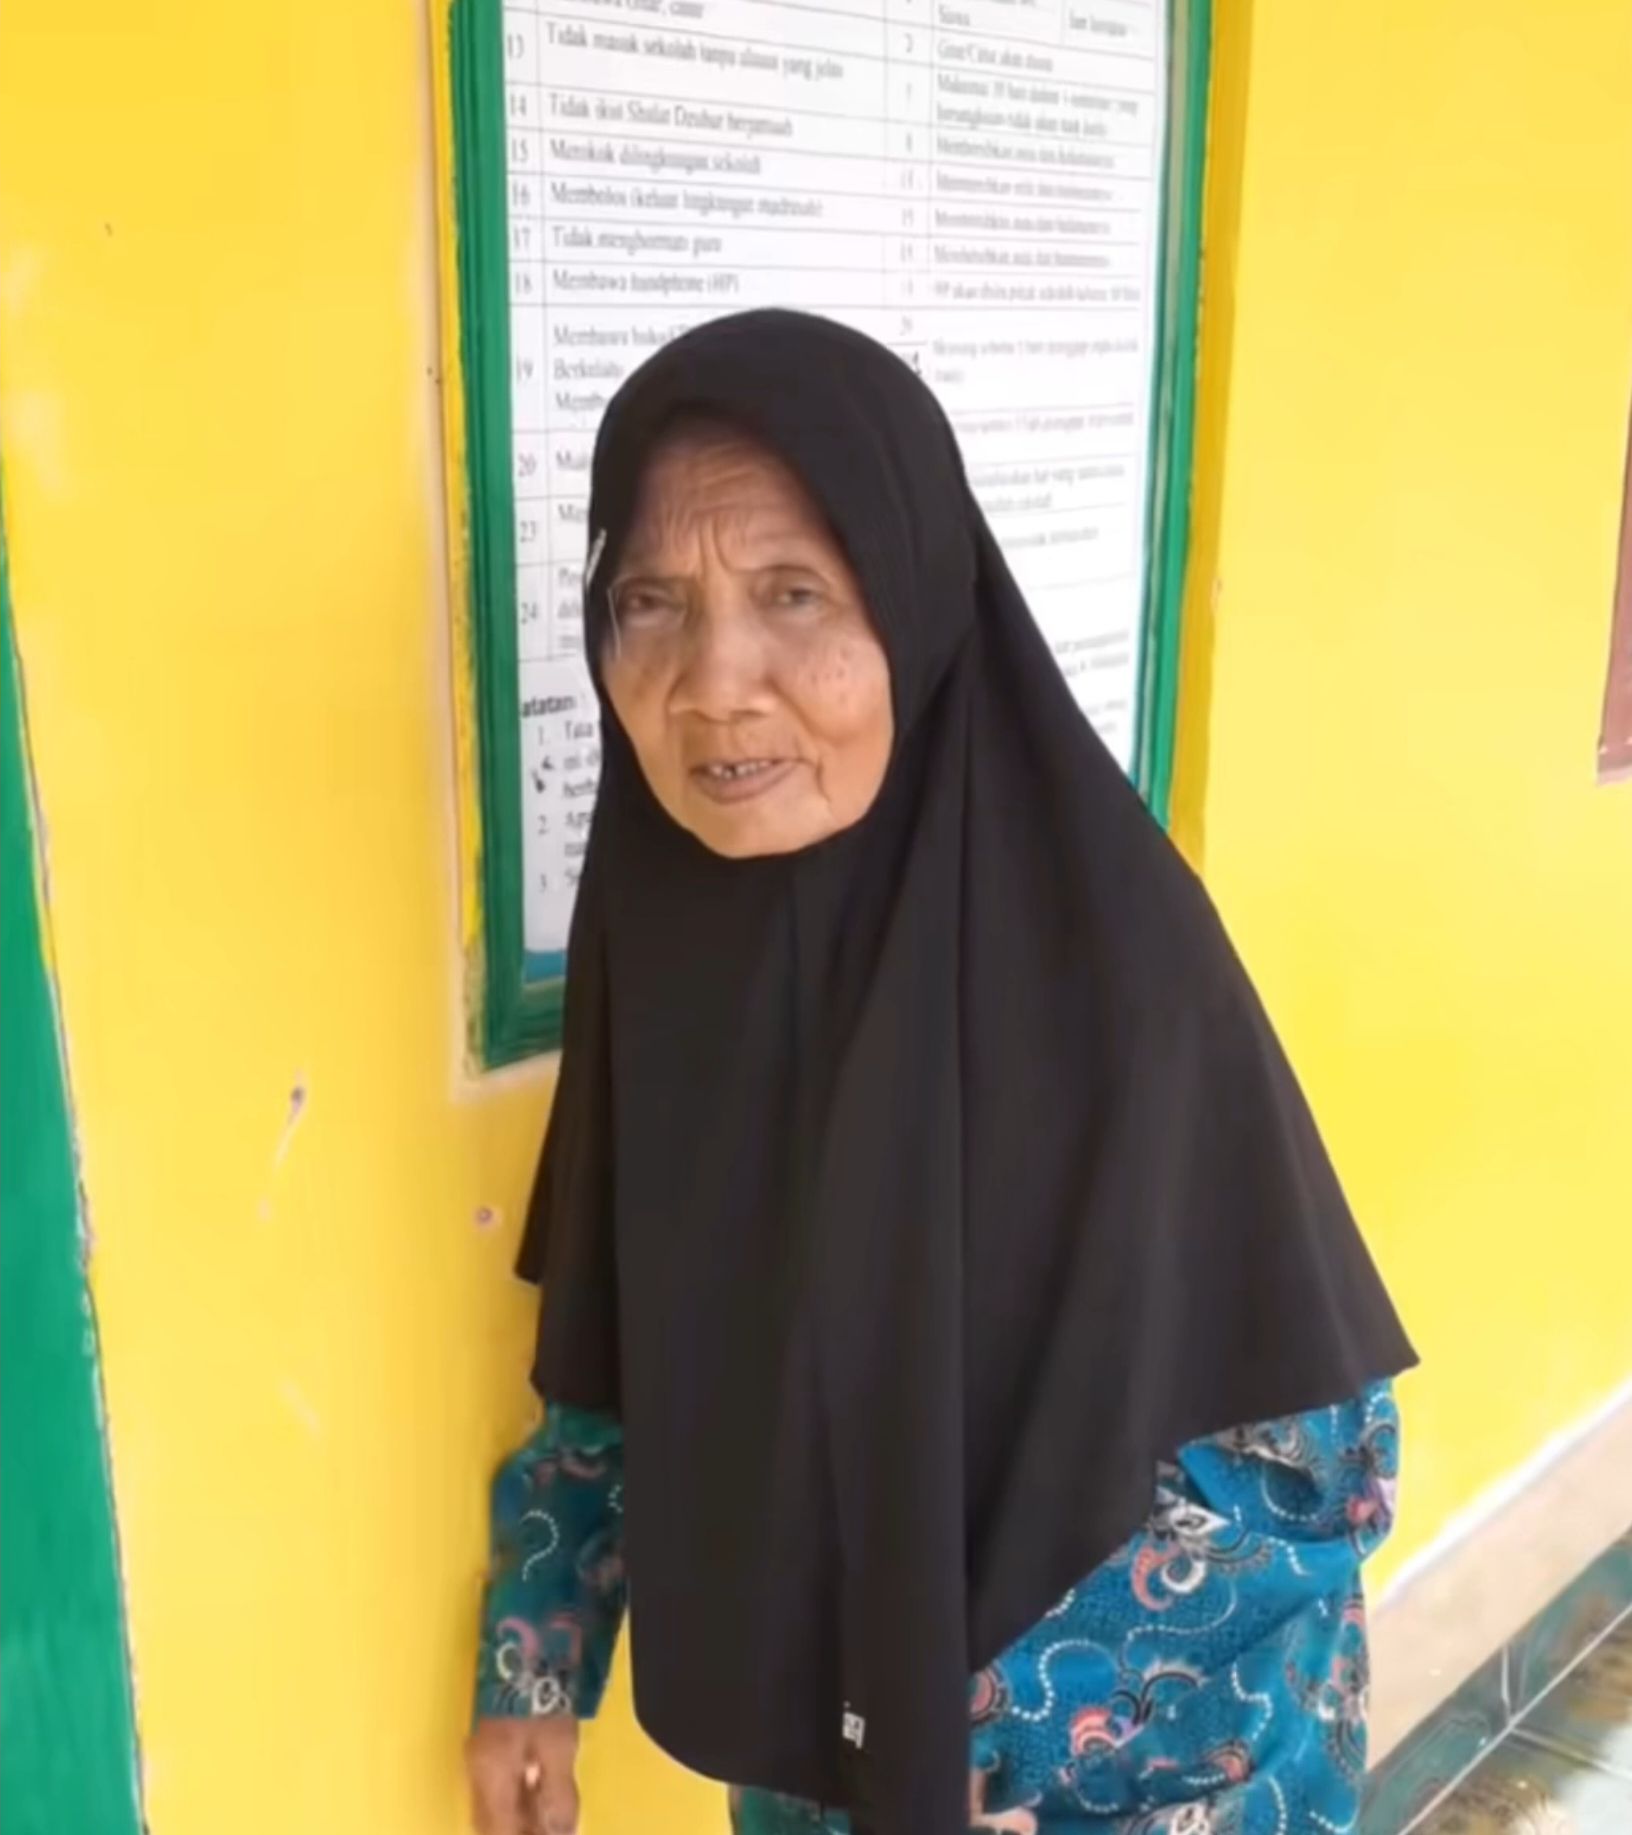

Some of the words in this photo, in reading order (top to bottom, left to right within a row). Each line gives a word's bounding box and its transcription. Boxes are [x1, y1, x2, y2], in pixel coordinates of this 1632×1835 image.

[546, 21, 587, 47] Tidak
[593, 33, 639, 53] masuk
[643, 36, 697, 61] sekolah
[509, 93, 527, 117] 14
[549, 92, 590, 118] Tidak
[511, 138, 528, 163] 15
[550, 138, 615, 164] Merokok
[713, 152, 760, 175] sekolah
[512, 182, 530, 206] 16
[514, 226, 531, 250] 17
[552, 225, 593, 249] Tidak
[692, 237, 722, 258] guru
[553, 269, 626, 293] Membawa
[630, 271, 705, 298] handphone
[553, 323, 628, 346] Membawa
[520, 696, 576, 718] atatan
